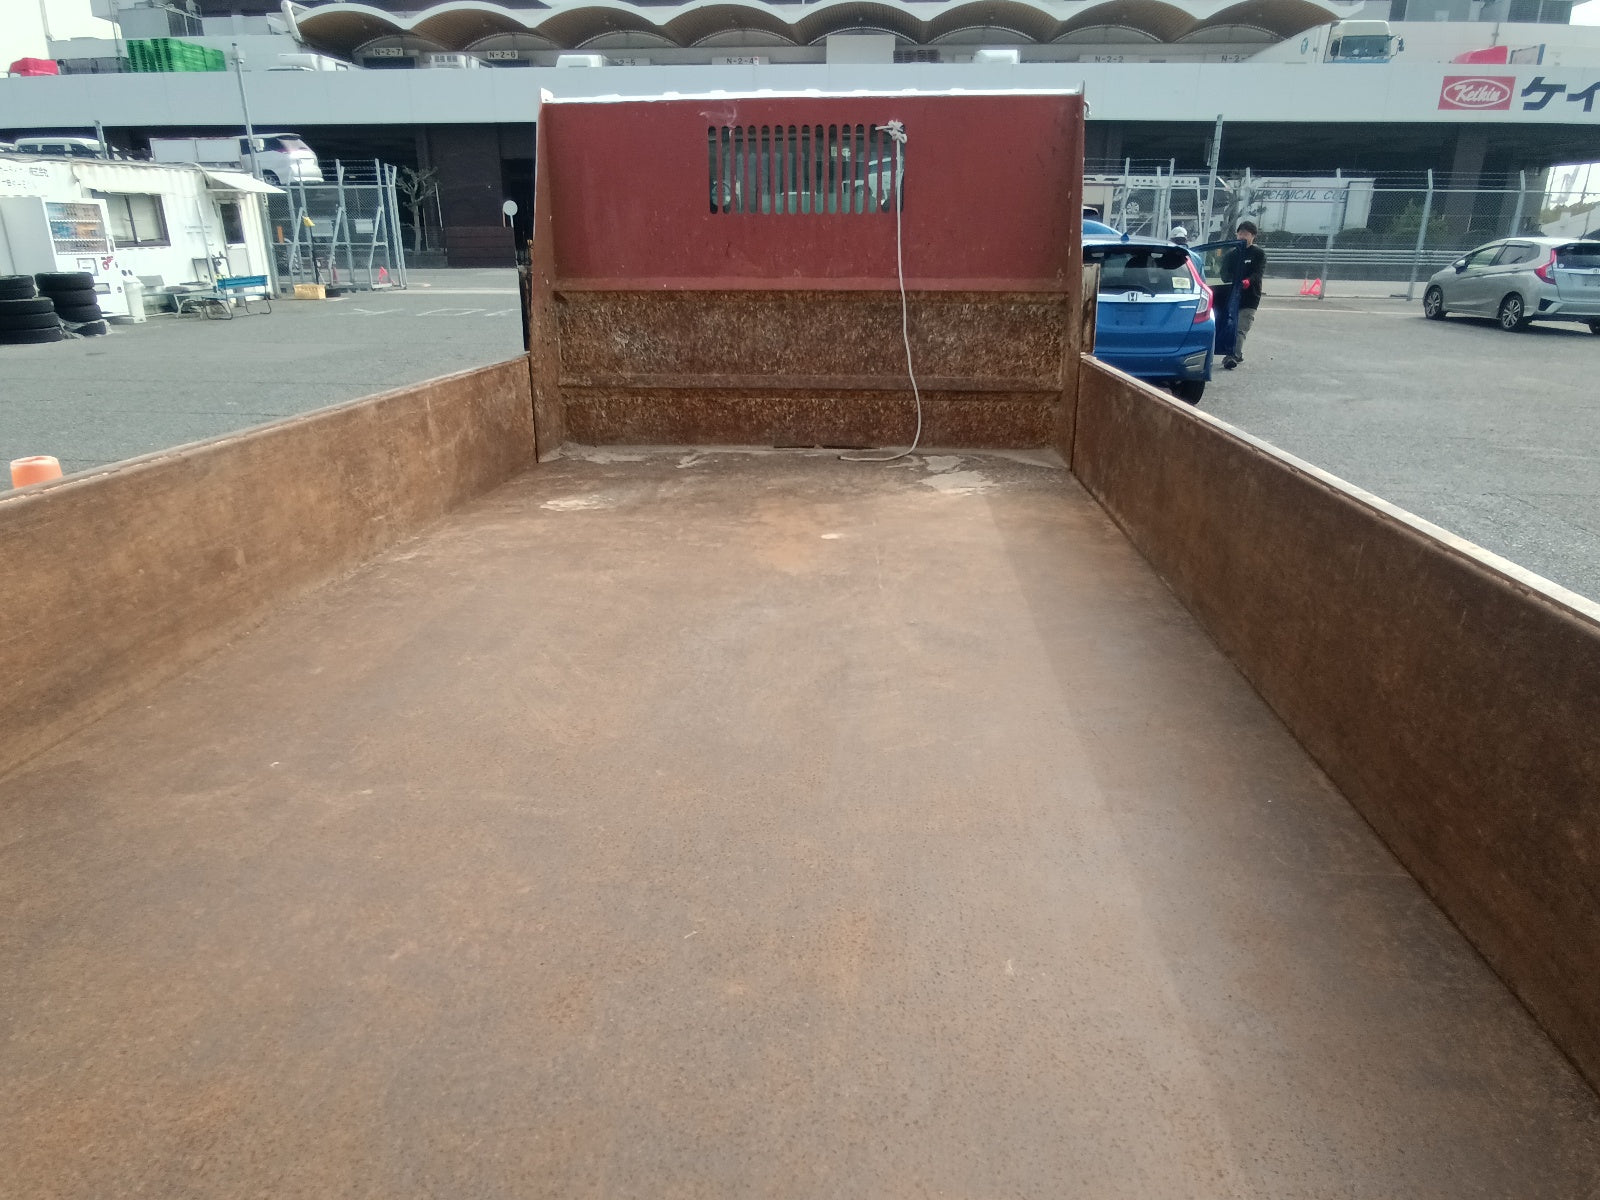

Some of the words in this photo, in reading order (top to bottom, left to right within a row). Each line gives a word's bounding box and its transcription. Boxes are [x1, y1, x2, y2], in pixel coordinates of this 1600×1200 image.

[374, 48, 401, 56] N-2-7
[1094, 55, 1124, 63] N-2-2
[1221, 54, 1251, 63] N-2-
[1520, 76, 1600, 112] ケイ
[1253, 189, 1317, 200] TECHNICAL
